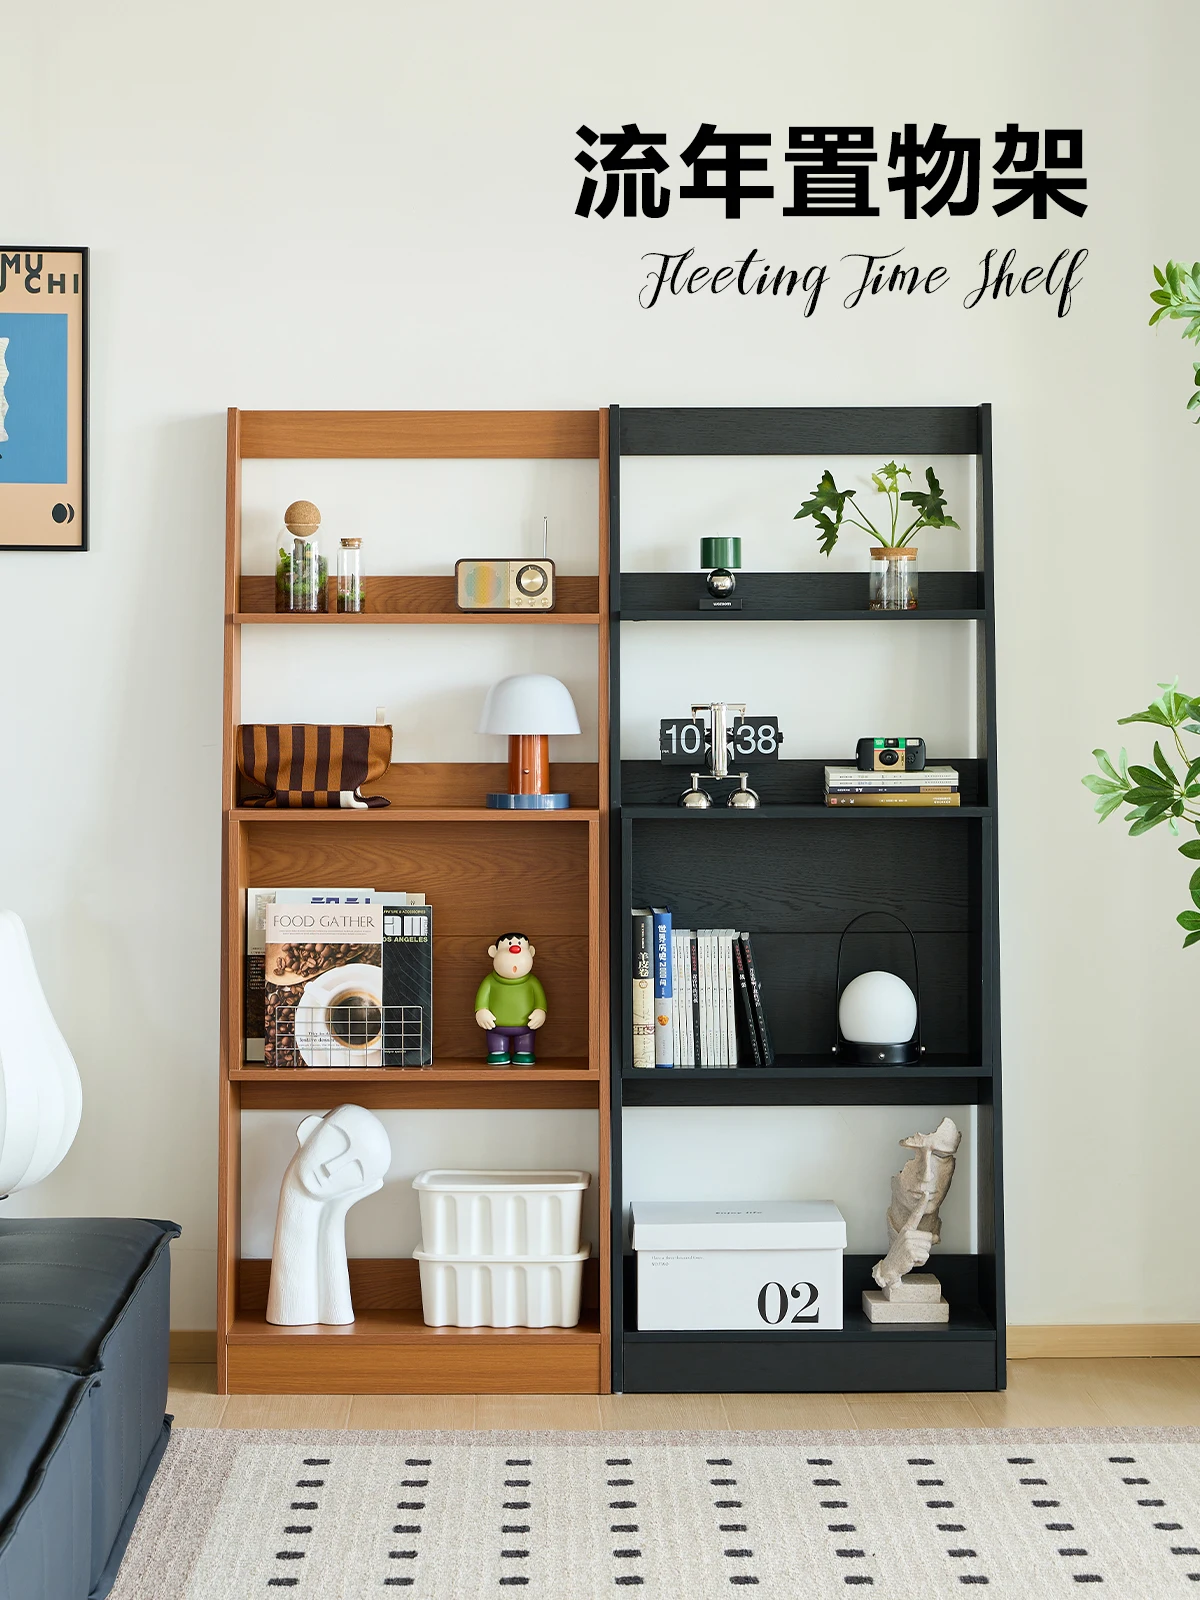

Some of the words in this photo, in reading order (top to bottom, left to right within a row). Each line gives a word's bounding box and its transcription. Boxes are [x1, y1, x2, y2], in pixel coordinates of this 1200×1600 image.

[665, 724, 701, 754] 10
[736, 724, 777, 754] 38
[273, 915, 315, 928] FOOD
[319, 915, 375, 928] GATHER
[757, 1281, 820, 1325] 02
